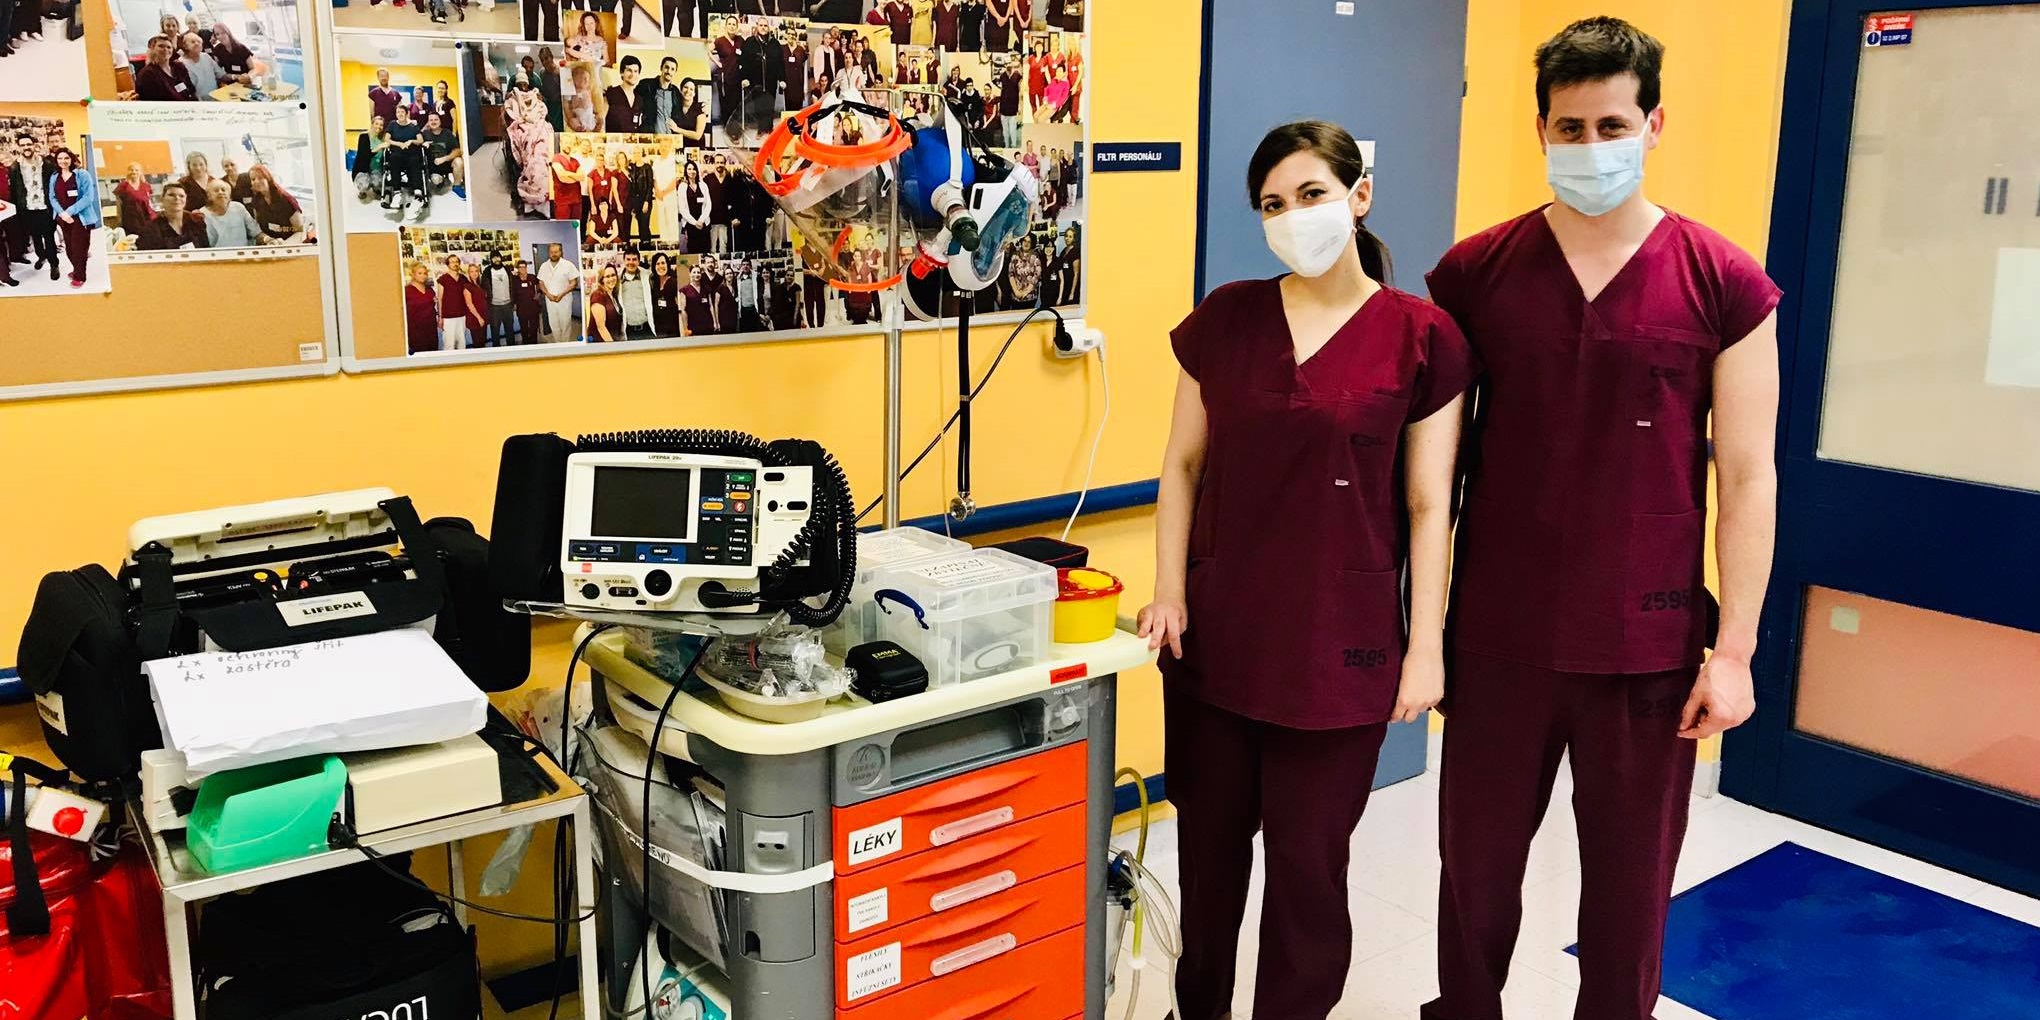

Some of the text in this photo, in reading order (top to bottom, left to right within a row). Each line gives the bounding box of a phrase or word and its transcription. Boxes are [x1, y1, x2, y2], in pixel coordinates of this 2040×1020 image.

[1097, 150, 1162, 162] FILTR PERSONÁLU
[302, 601, 364, 616] LIFEPAK
[871, 649, 899, 660] EMMA
[1343, 648, 1387, 668] 2595
[853, 829, 897, 855] LÉKY
